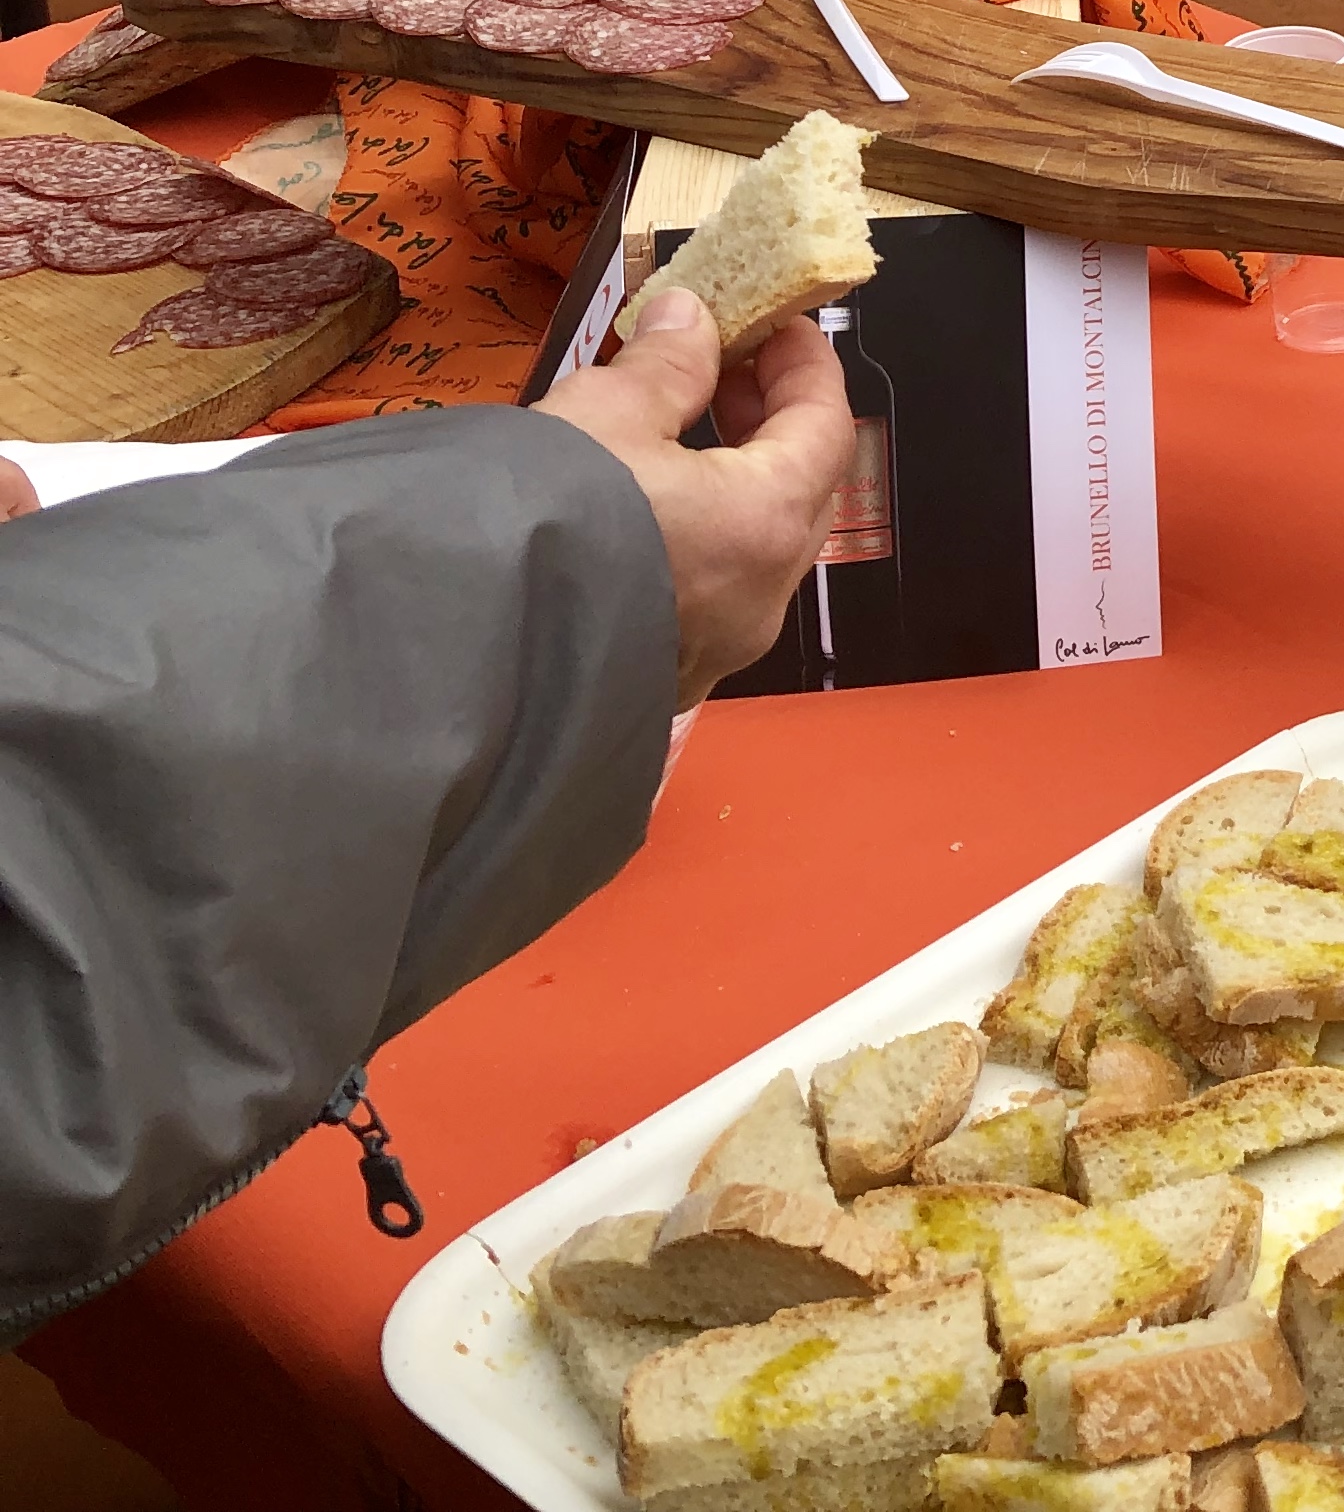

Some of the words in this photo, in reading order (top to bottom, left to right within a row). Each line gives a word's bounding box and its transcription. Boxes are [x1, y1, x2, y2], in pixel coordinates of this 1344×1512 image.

[1082, 239, 1105, 391] MONTALCIN
[1086, 400, 1106, 427] DI
[1086, 433, 1112, 572] BRUNELLO
[1056, 638, 1079, 662] Col
[1083, 642, 1098, 655] di
